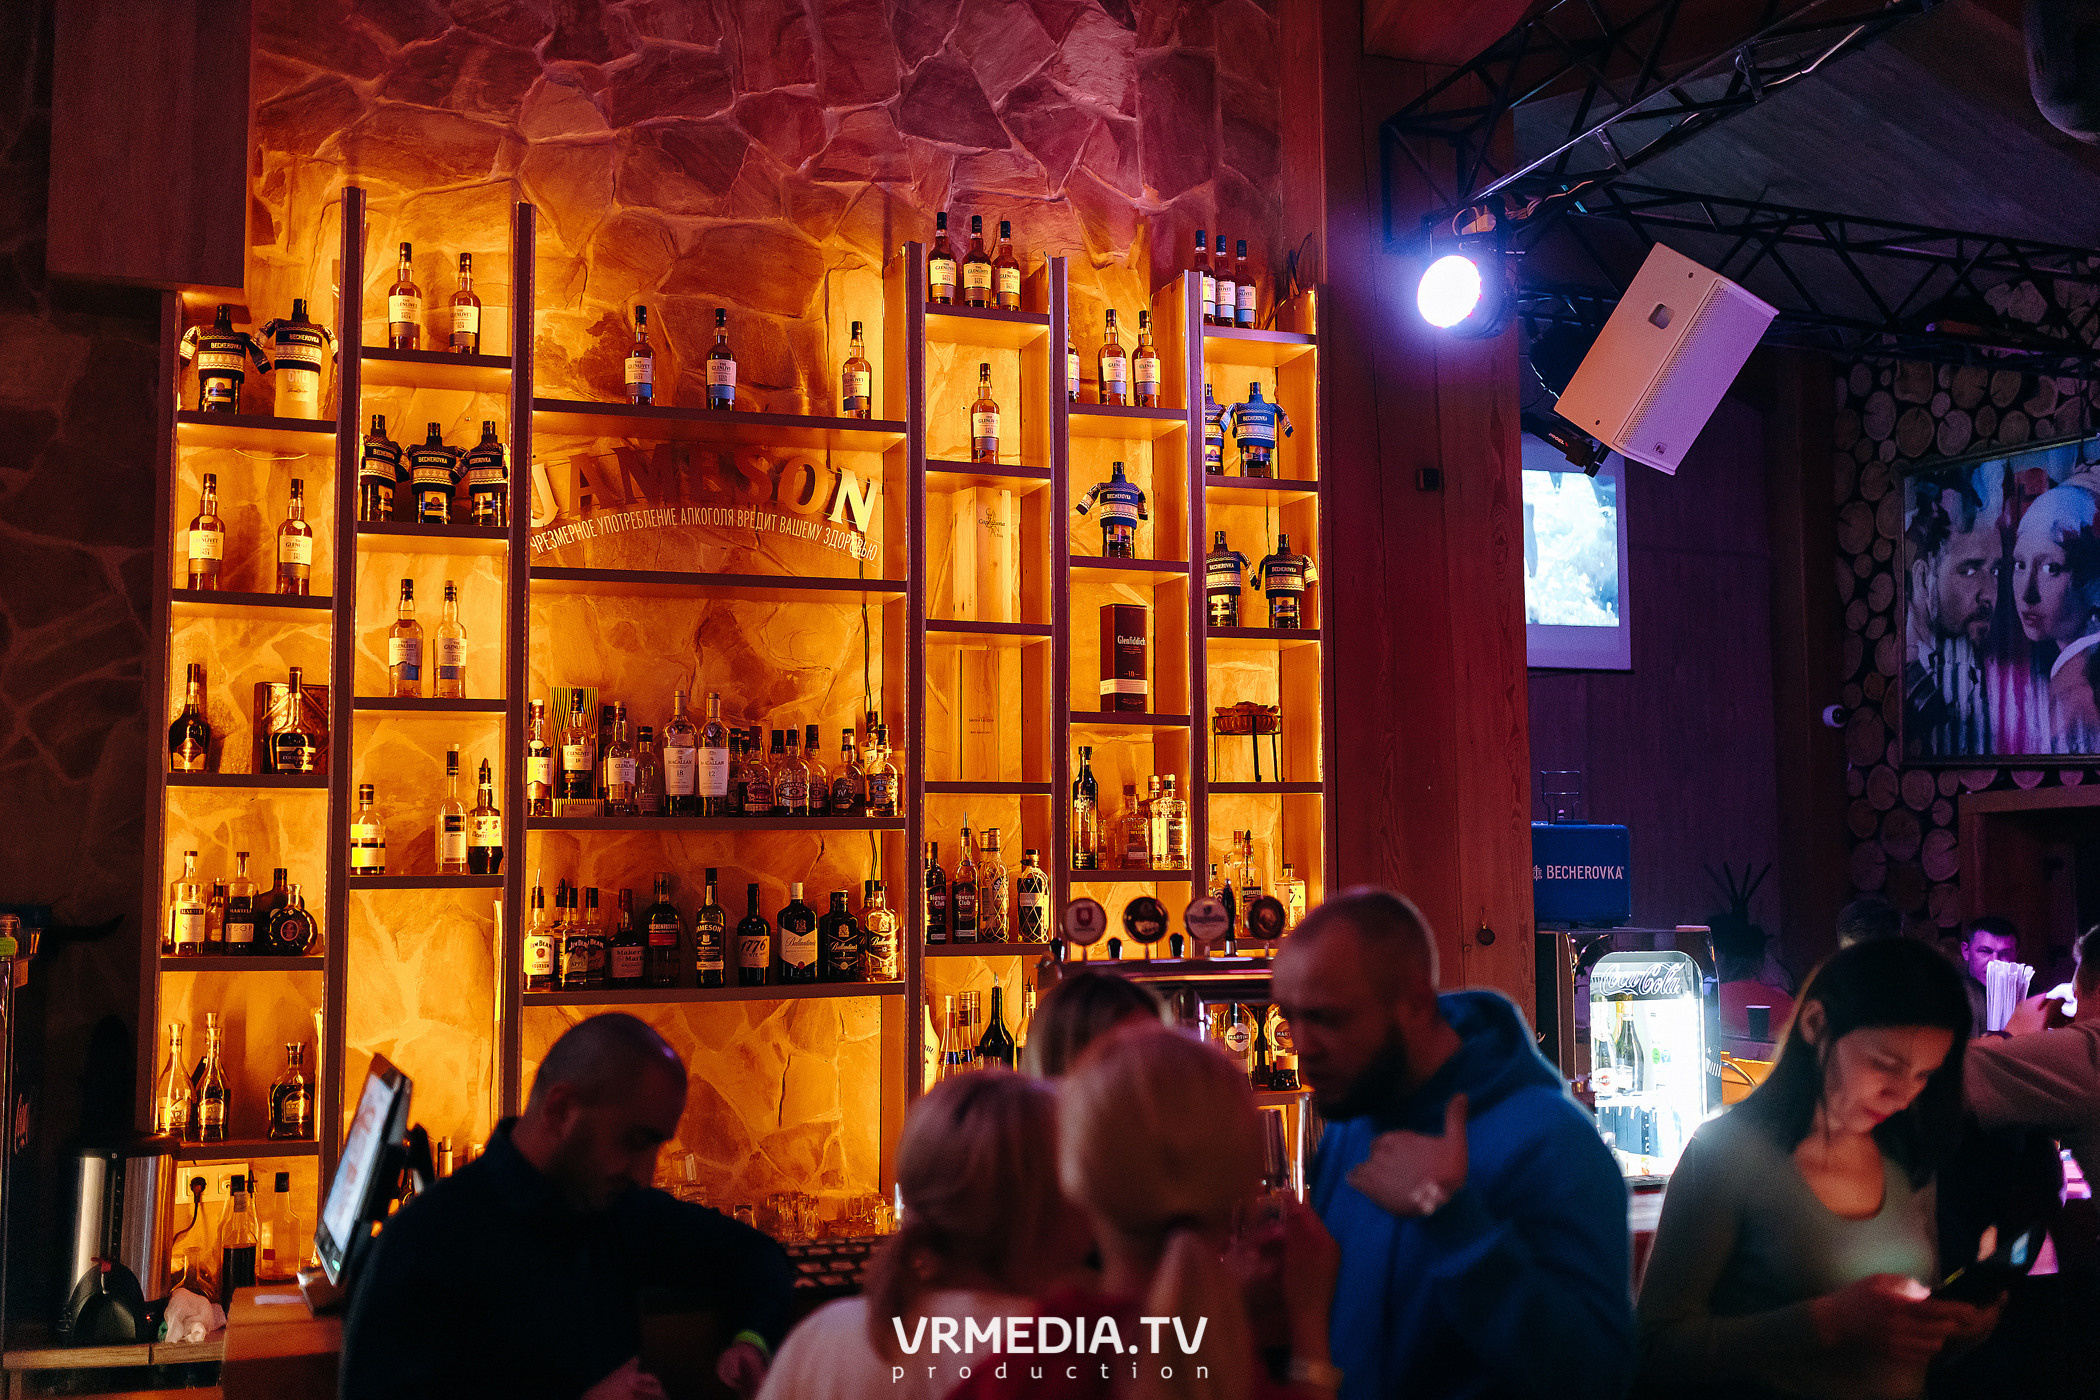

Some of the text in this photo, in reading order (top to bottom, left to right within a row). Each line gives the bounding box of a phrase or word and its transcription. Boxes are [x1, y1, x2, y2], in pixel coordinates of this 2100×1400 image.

[418, 456, 448, 464] BECHEROVKA
[531, 442, 878, 533] JAMESON
[530, 507, 878, 561] ЧРЕЗМЕРНОЕ УПОТРЕБЛЕНИЕ АЛКОГОЛЯ ВРЕДИТ ВАШЕМУ ЗДОРОВЬЮ
[1117, 635, 1146, 646] Glenfiddich
[1546, 865, 1623, 880] BECHEROVKA
[696, 924, 722, 933] AMESON
[741, 938, 767, 953] 1776
